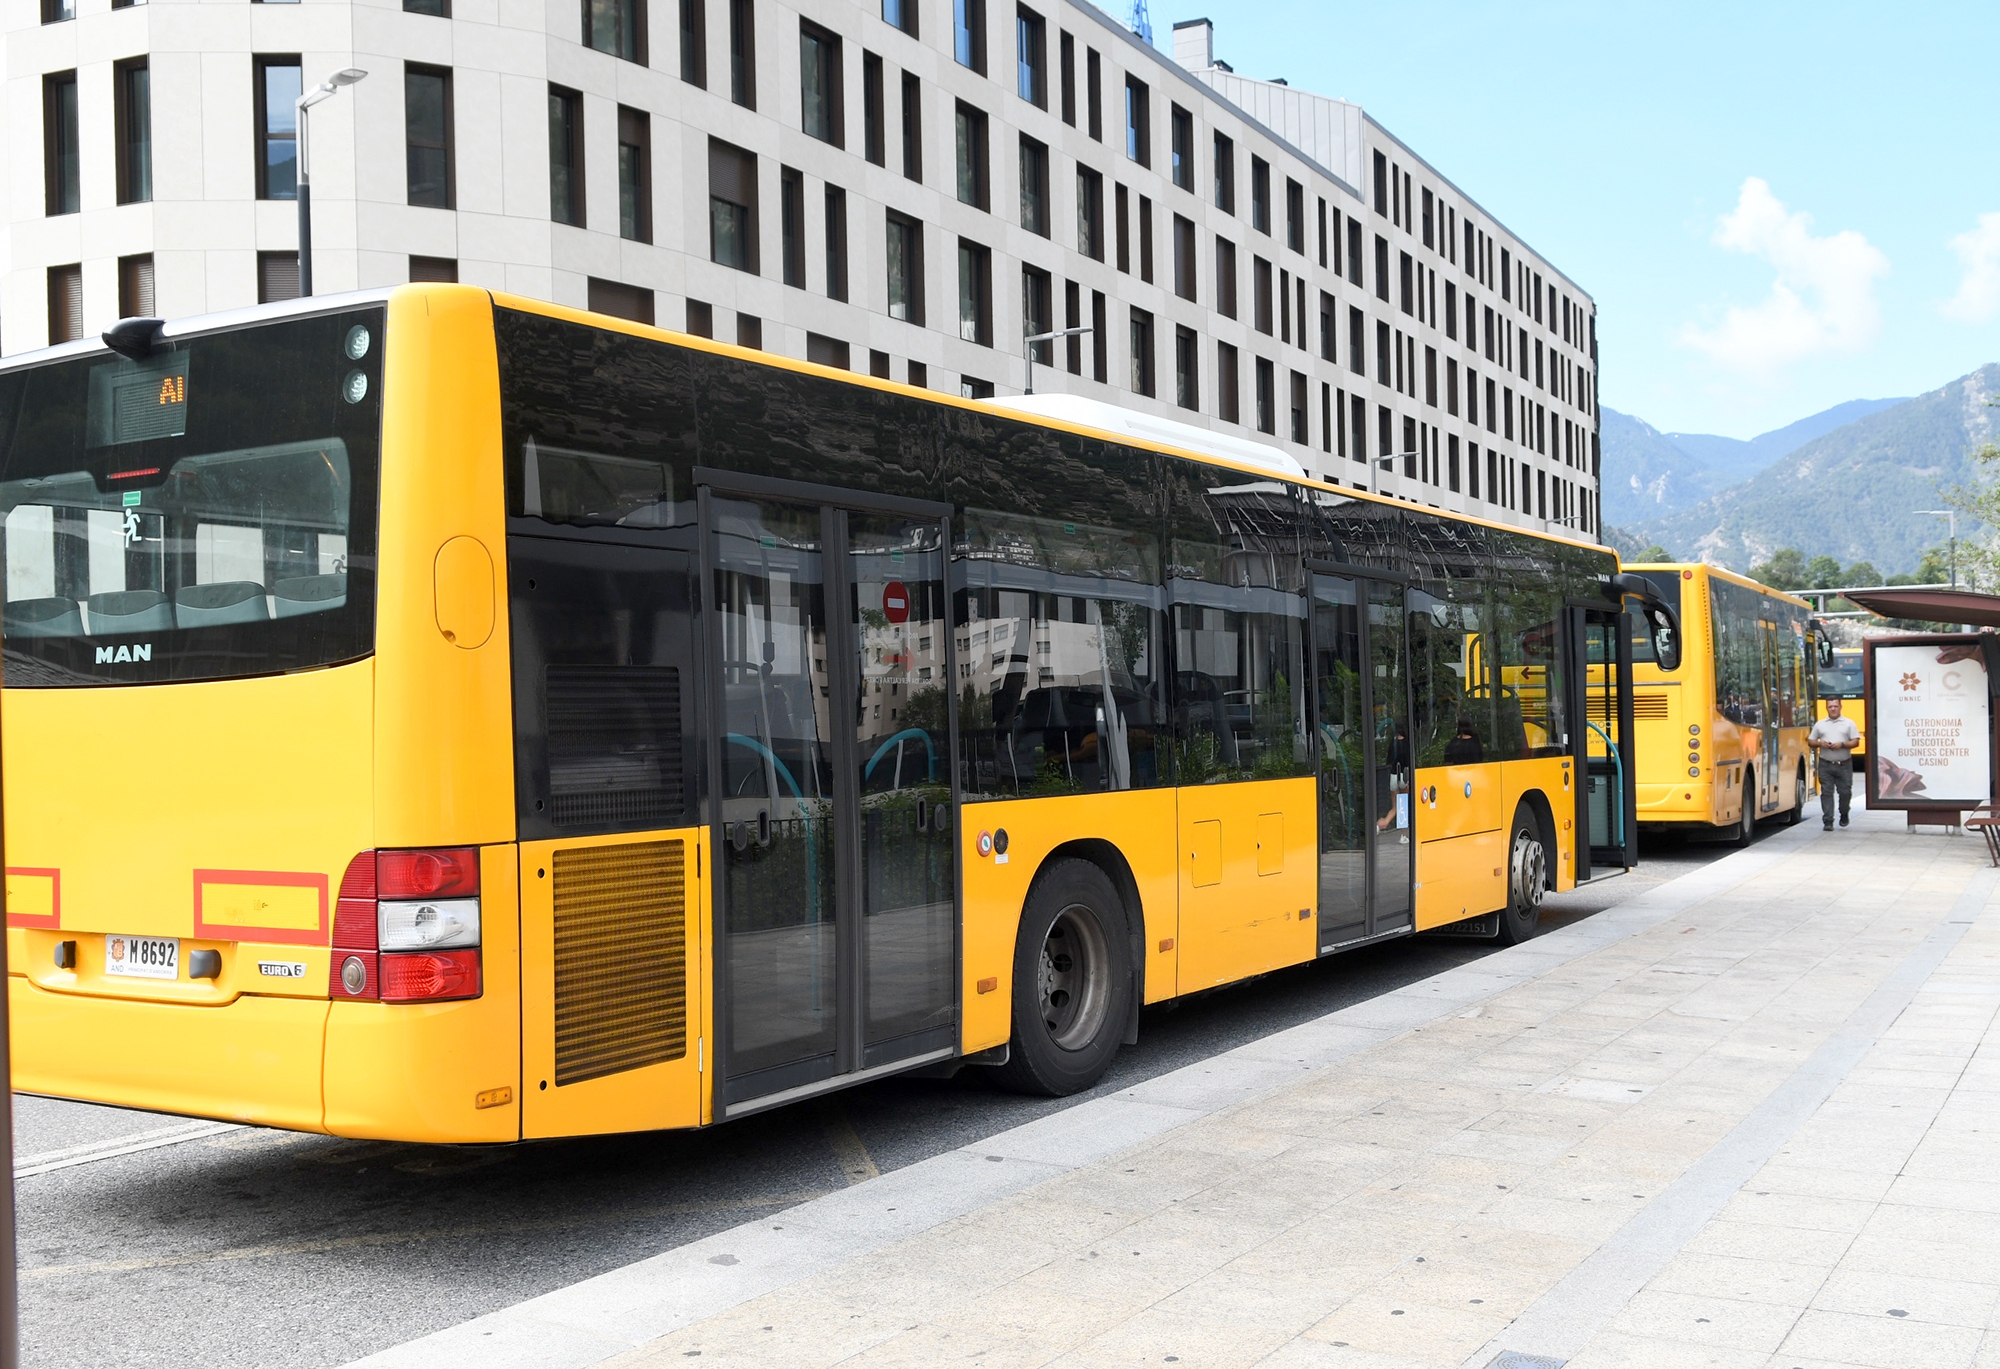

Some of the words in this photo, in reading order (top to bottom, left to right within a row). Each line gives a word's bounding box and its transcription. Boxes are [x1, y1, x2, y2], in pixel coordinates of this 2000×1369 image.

[95, 643, 152, 665] MAN
[1904, 718, 1963, 728] GASTRONOMIA
[1907, 728, 1960, 737] ESPECTACLES
[1911, 738, 1956, 747] DISCOTECA
[1898, 748, 1937, 757] BUSINESS
[1939, 748, 1970, 757] CENTER
[1918, 758, 1949, 767] CASINO
[129, 939, 139, 964] M
[141, 940, 175, 967] 8692
[111, 964, 124, 973] AND
[261, 965, 289, 976] EURO
